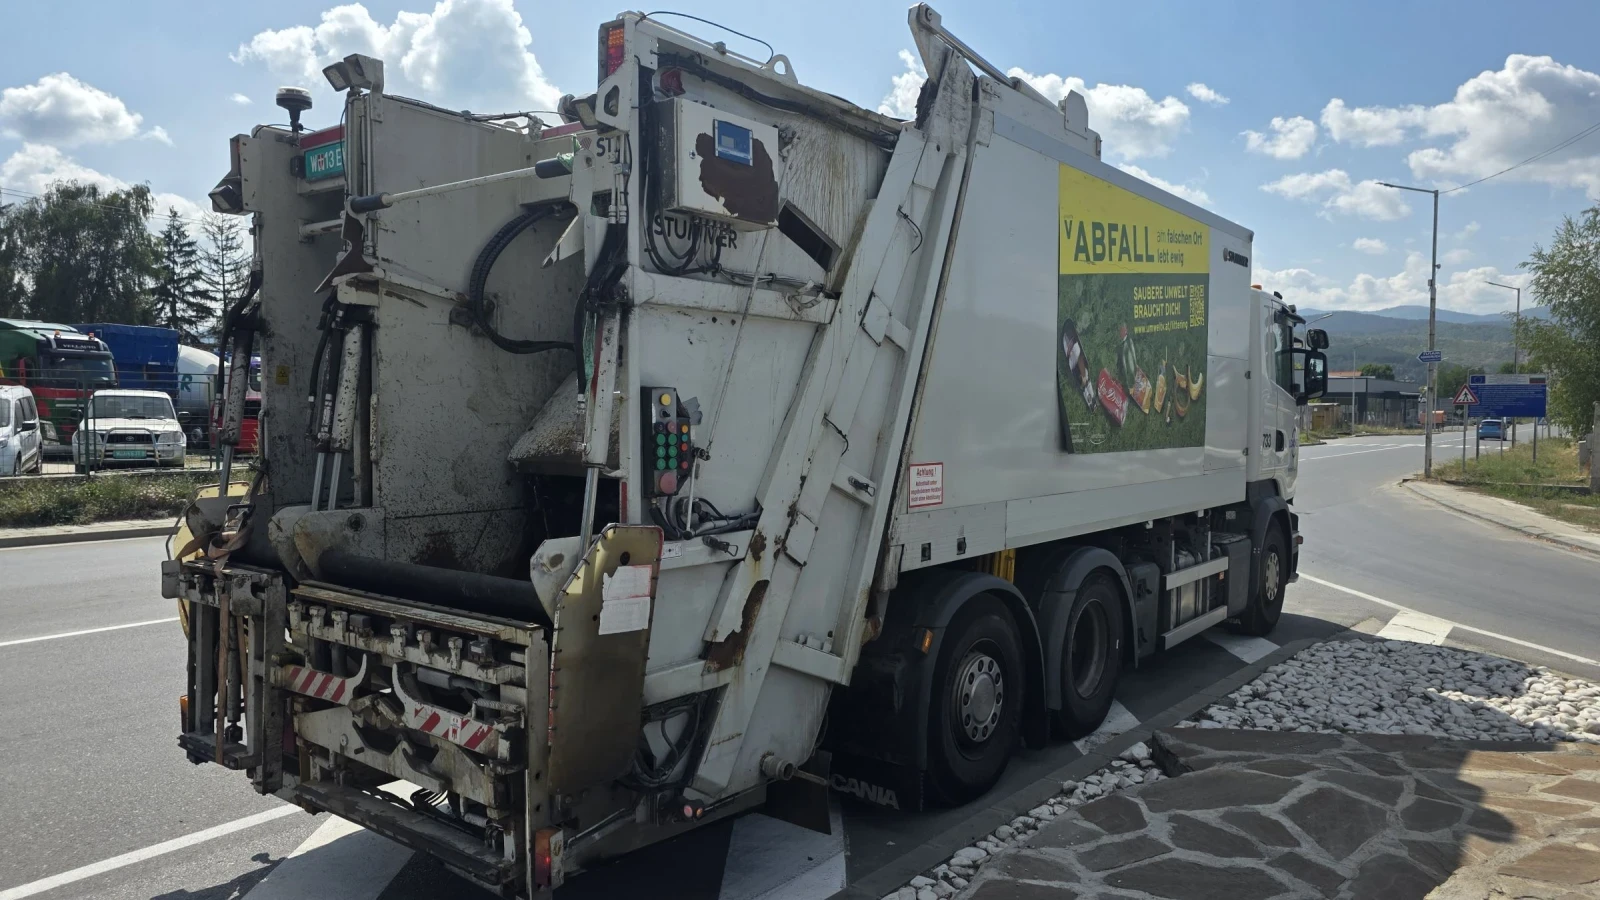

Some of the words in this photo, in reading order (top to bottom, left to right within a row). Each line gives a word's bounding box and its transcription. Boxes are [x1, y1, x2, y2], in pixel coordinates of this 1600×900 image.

[1074, 220, 1155, 263] ABFALL
[1156, 231, 1167, 243] am
[1167, 229, 1193, 245] falschen
[1192, 230, 1203, 245] Ort
[1157, 250, 1169, 264] lebt
[1170, 250, 1184, 267] ewig
[1133, 285, 1164, 301] SAUBERE
[1164, 285, 1188, 299] UMWELT
[1134, 303, 1164, 319] BRAUCHT
[1165, 302, 1181, 316] DICH!
[1262, 433, 1272, 448] 733
[832, 773, 901, 811] CANIA
